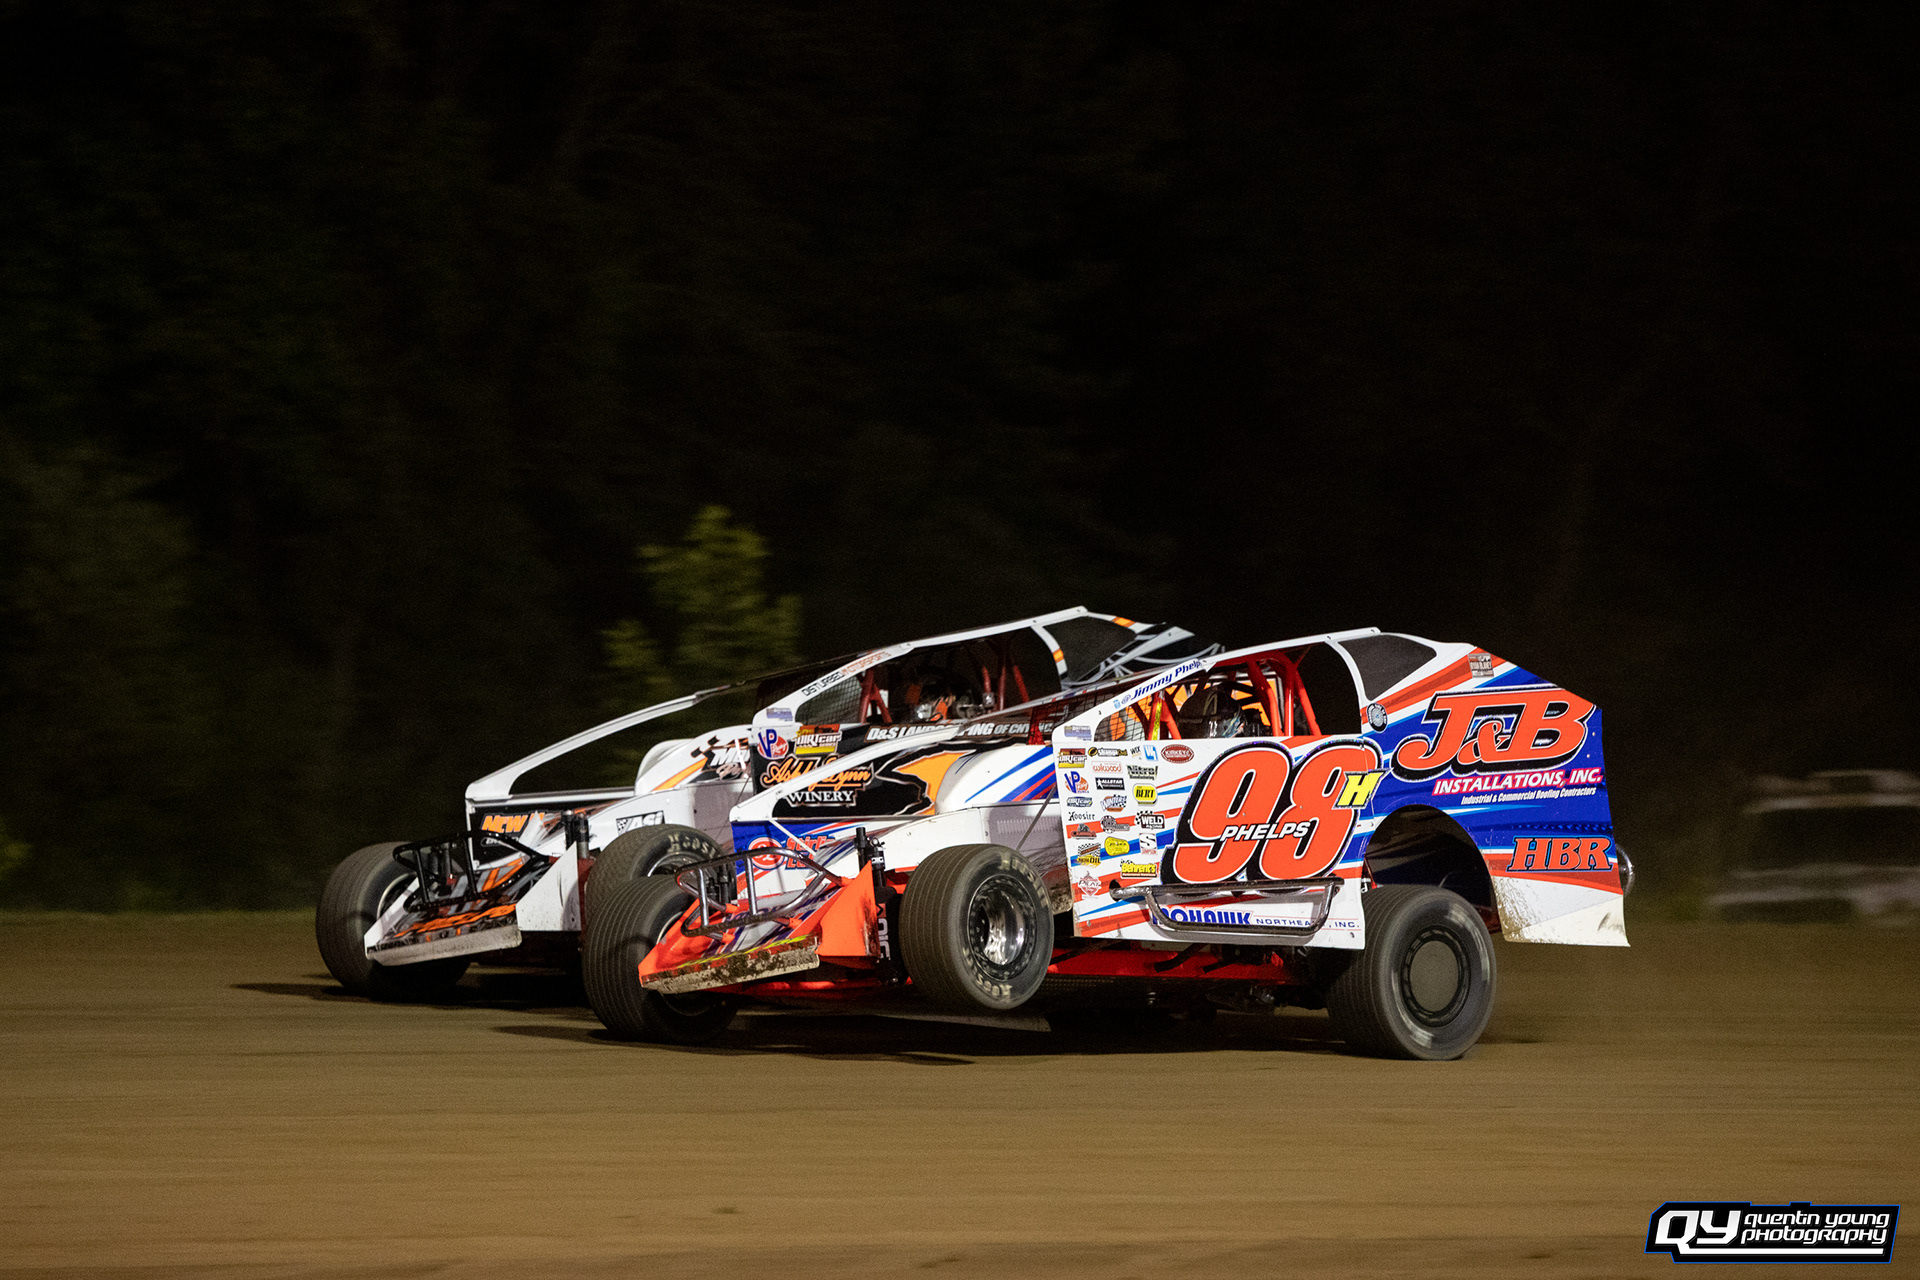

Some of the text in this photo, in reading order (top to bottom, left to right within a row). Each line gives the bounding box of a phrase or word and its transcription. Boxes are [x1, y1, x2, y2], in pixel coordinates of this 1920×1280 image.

[1175, 660, 1202, 677] Phelp
[867, 727, 898, 740] D&S
[994, 724, 1010, 734] OF
[1396, 687, 1596, 769] J&B
[758, 729, 778, 758] VP
[1064, 771, 1080, 794] VP
[1434, 768, 1602, 795] INSTALLATIONS, INC.
[788, 791, 854, 802] WINERY
[1136, 789, 1154, 798] BERT
[1461, 794, 1492, 805] Industrial
[1498, 790, 1536, 802] Commercial
[1536, 789, 1560, 799] Roofing
[1560, 787, 1597, 798] Contractors
[481, 815, 528, 833] NEW
[1068, 811, 1095, 821] Hoosier
[1141, 816, 1163, 825] WELD
[1173, 747, 1383, 883] 98 H
[1220, 822, 1310, 841] PHELPS
[1508, 837, 1613, 871] HBR
[1335, 921, 1360, 929] INC.
